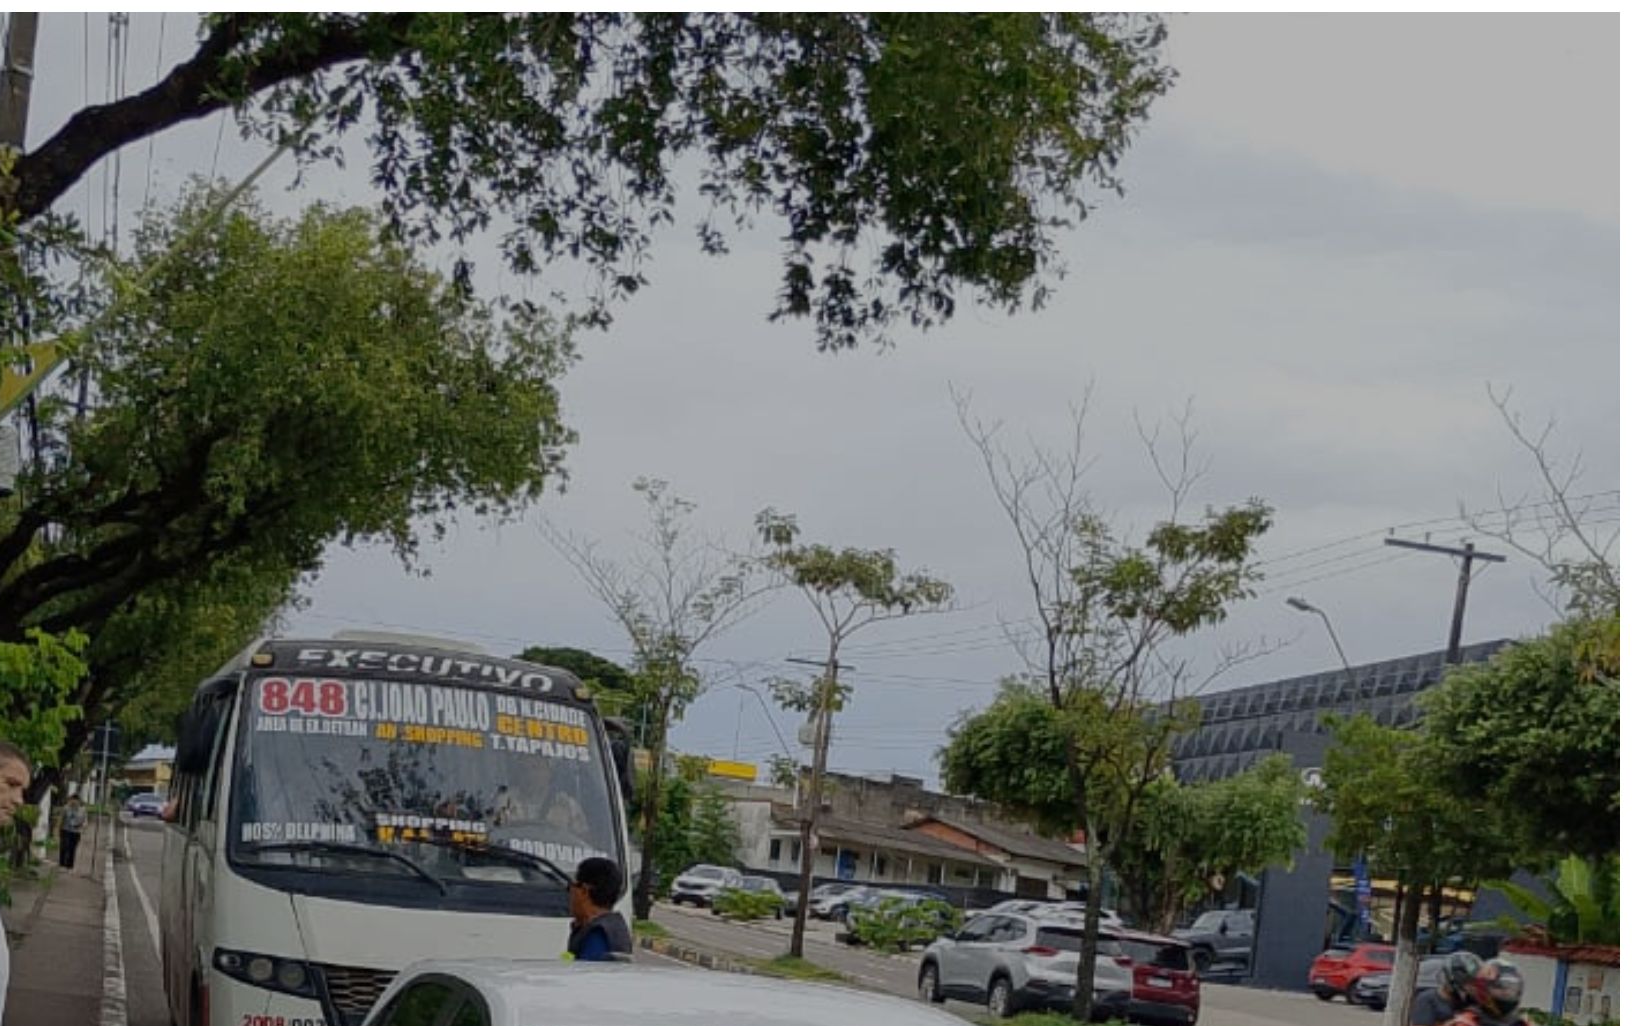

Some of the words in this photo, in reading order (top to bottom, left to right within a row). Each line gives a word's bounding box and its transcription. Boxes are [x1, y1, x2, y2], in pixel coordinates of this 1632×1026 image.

[297, 649, 554, 692] EXECUTIVO
[260, 677, 347, 717] 848
[431, 688, 490, 732] PAULO
[496, 713, 589, 746] CENTRO
